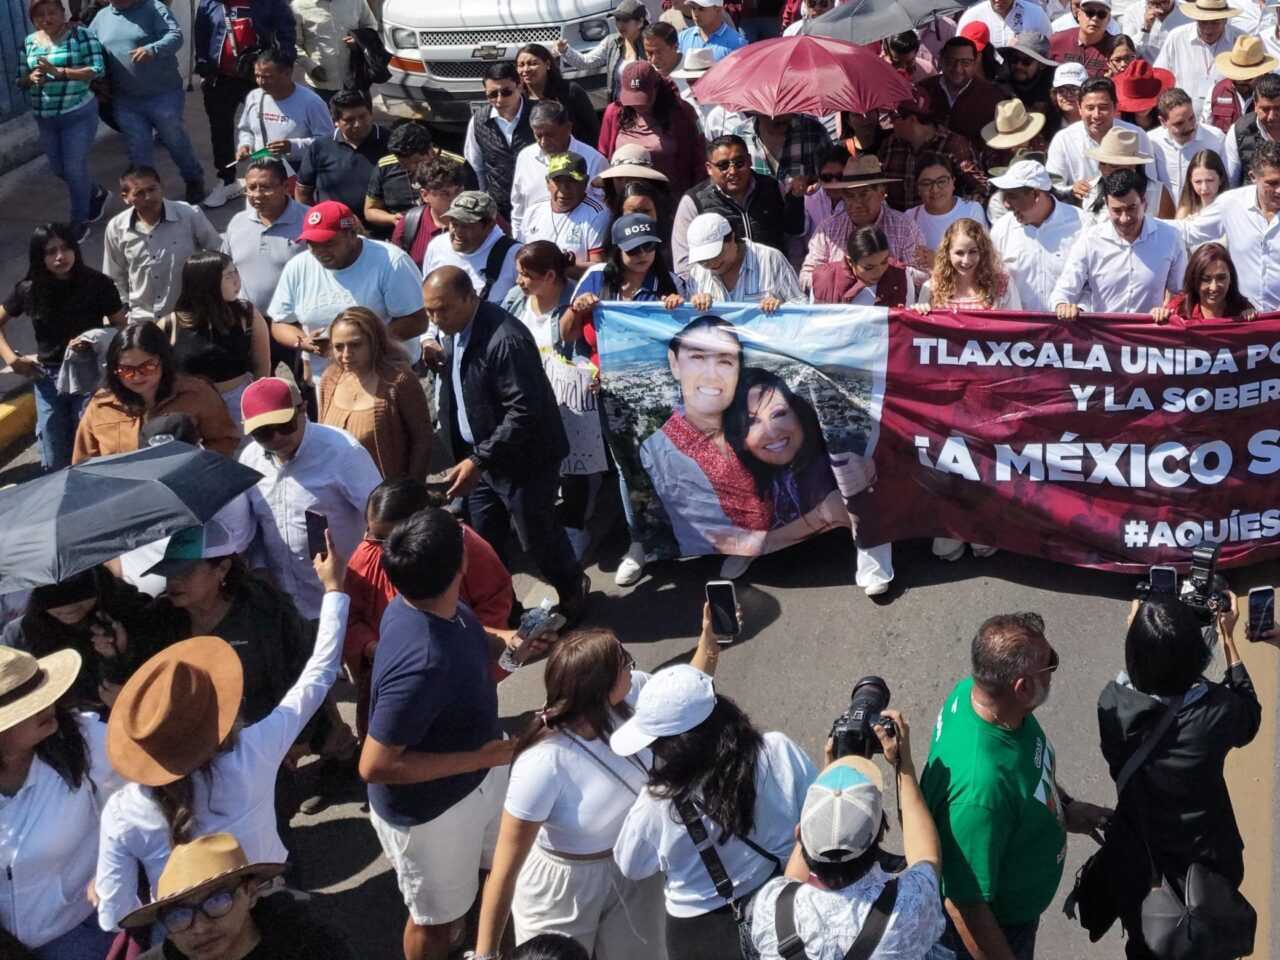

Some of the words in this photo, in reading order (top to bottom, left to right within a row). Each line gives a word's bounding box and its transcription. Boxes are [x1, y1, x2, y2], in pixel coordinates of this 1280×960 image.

[624, 223, 651, 237] BOSS
[912, 337, 1112, 373] TLAXCALA
[1121, 346, 1239, 375] UNIDA
[1070, 385, 1093, 411] Y
[1104, 385, 1154, 411] LA
[993, 431, 1233, 488] MÉXICO
